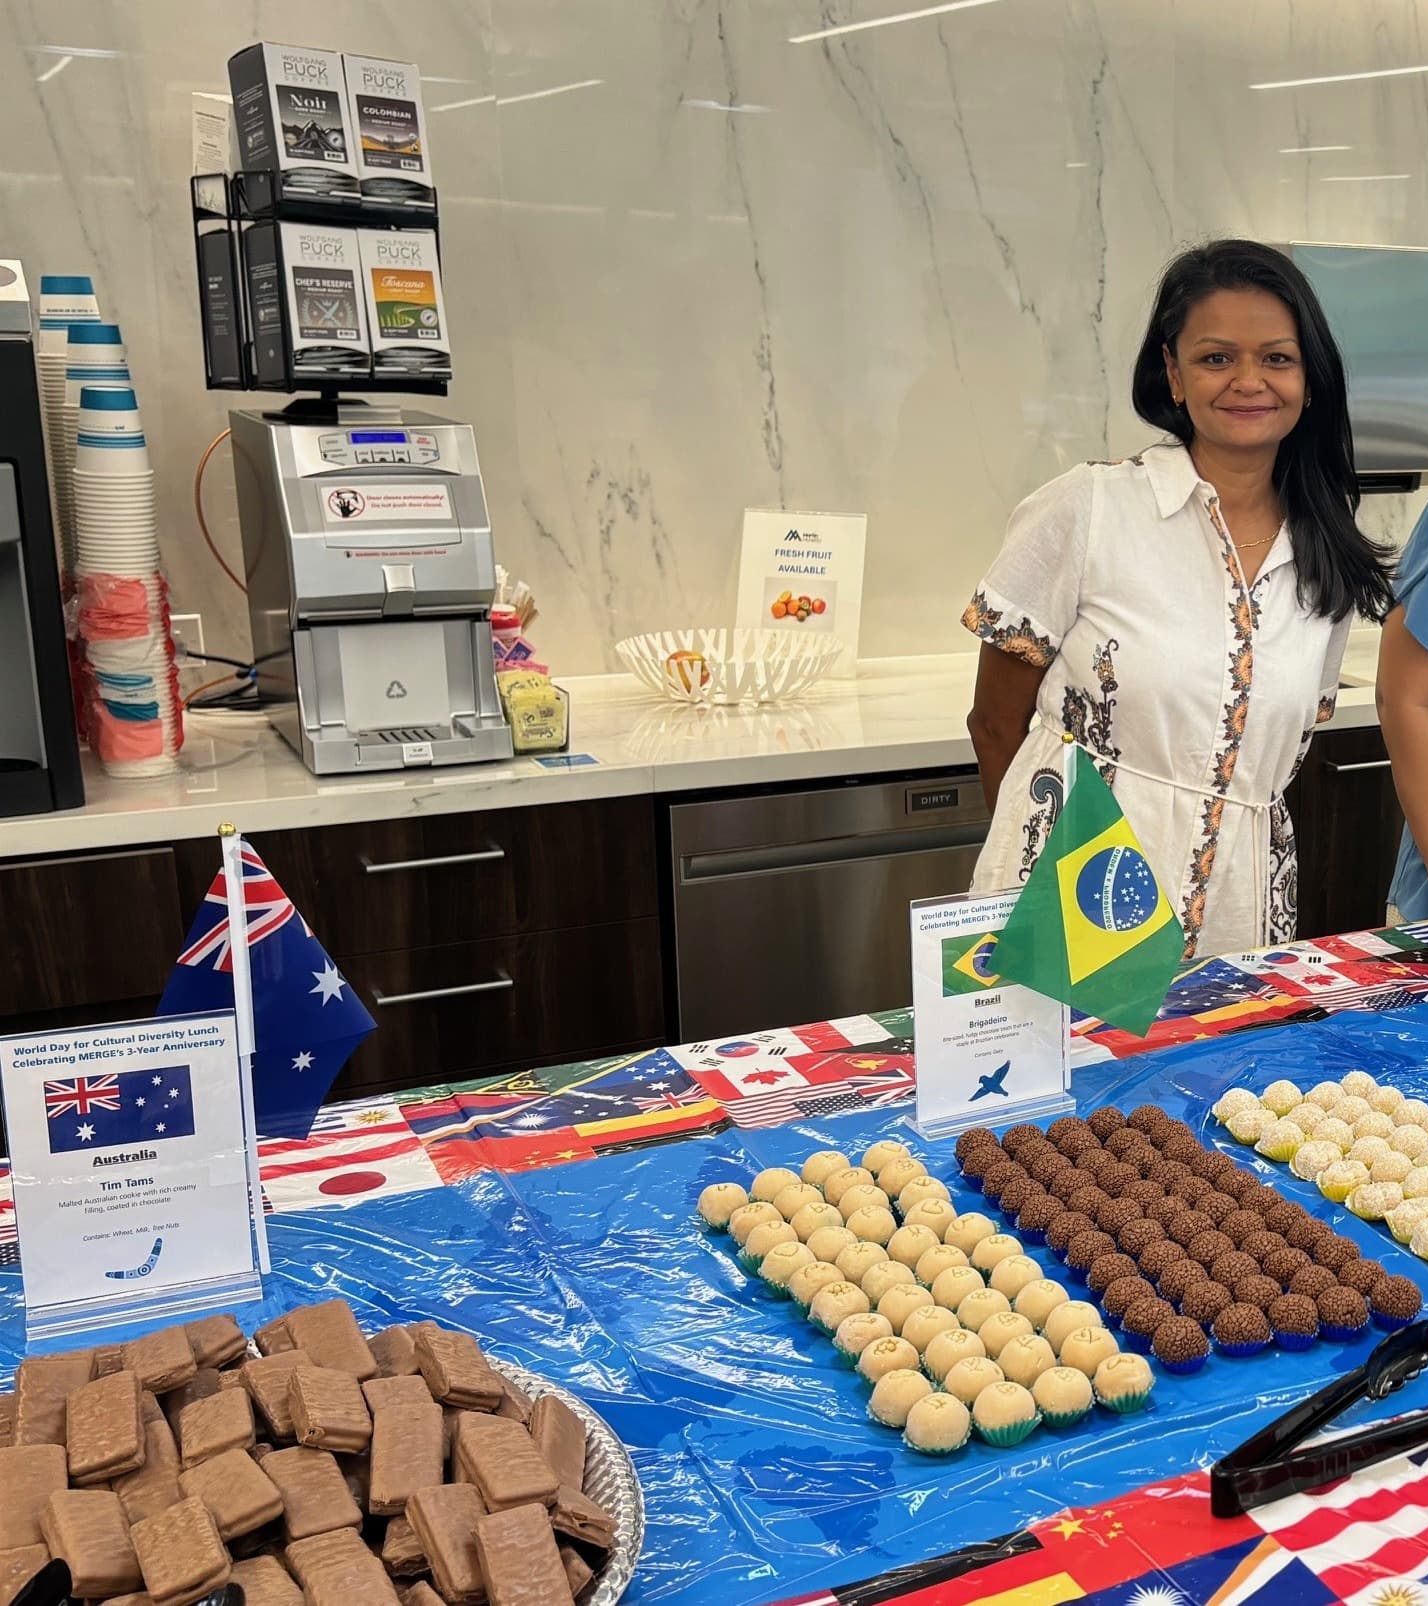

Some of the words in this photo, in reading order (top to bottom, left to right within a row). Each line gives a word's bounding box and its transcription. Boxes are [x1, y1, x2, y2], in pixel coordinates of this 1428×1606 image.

[283, 62, 328, 79] PUCK
[363, 73, 406, 89] PUCK
[362, 106, 412, 119] COLOMBIAN
[300, 241, 344, 257] PUCK
[377, 246, 422, 260] PUCK
[381, 275, 426, 289] Toscana
[775, 548, 804, 558] FRESH
[806, 550, 832, 560] FRUIT
[778, 564, 826, 575] AVAILABLE
[921, 794, 951, 805] DIRTY
[920, 911, 942, 921] World
[943, 910, 958, 918] Day
[970, 903, 998, 913] Cultural
[919, 919, 960, 931] Celebrating
[961, 915, 990, 925] MERGE's
[991, 911, 1011, 920] 3-Yea
[974, 994, 1001, 1008] Brazil
[969, 1015, 1008, 1029] Brigadeiro
[14, 1045, 47, 1056] World
[49, 1043, 70, 1052] Day
[74, 1040, 90, 1049] for
[93, 1034, 135, 1047] Cultural
[138, 1029, 185, 1042] Diversity
[188, 1025, 219, 1036] Lunch
[12, 1055, 76, 1069] Celebrating
[78, 1049, 124, 1061] MERGE's
[126, 1045, 160, 1056] 3-Year
[162, 1038, 226, 1052] Anniversary
[93, 1149, 158, 1167] Australia
[100, 1180, 122, 1191] Tim
[125, 1177, 154, 1188] Tams
[58, 1199, 83, 1209] Malted
[84, 1195, 118, 1205] Australian
[119, 1191, 141, 1200] cookie
[142, 1188, 158, 1197] with
[159, 1186, 172, 1194] rich
[172, 1183, 197, 1193] creamy
[106, 1201, 130, 1211] coated
[131, 1199, 138, 1207] in
[139, 1196, 171, 1206] chocolate
[82, 1232, 111, 1242] Contains:
[165, 1221, 180, 1230] Nuts
